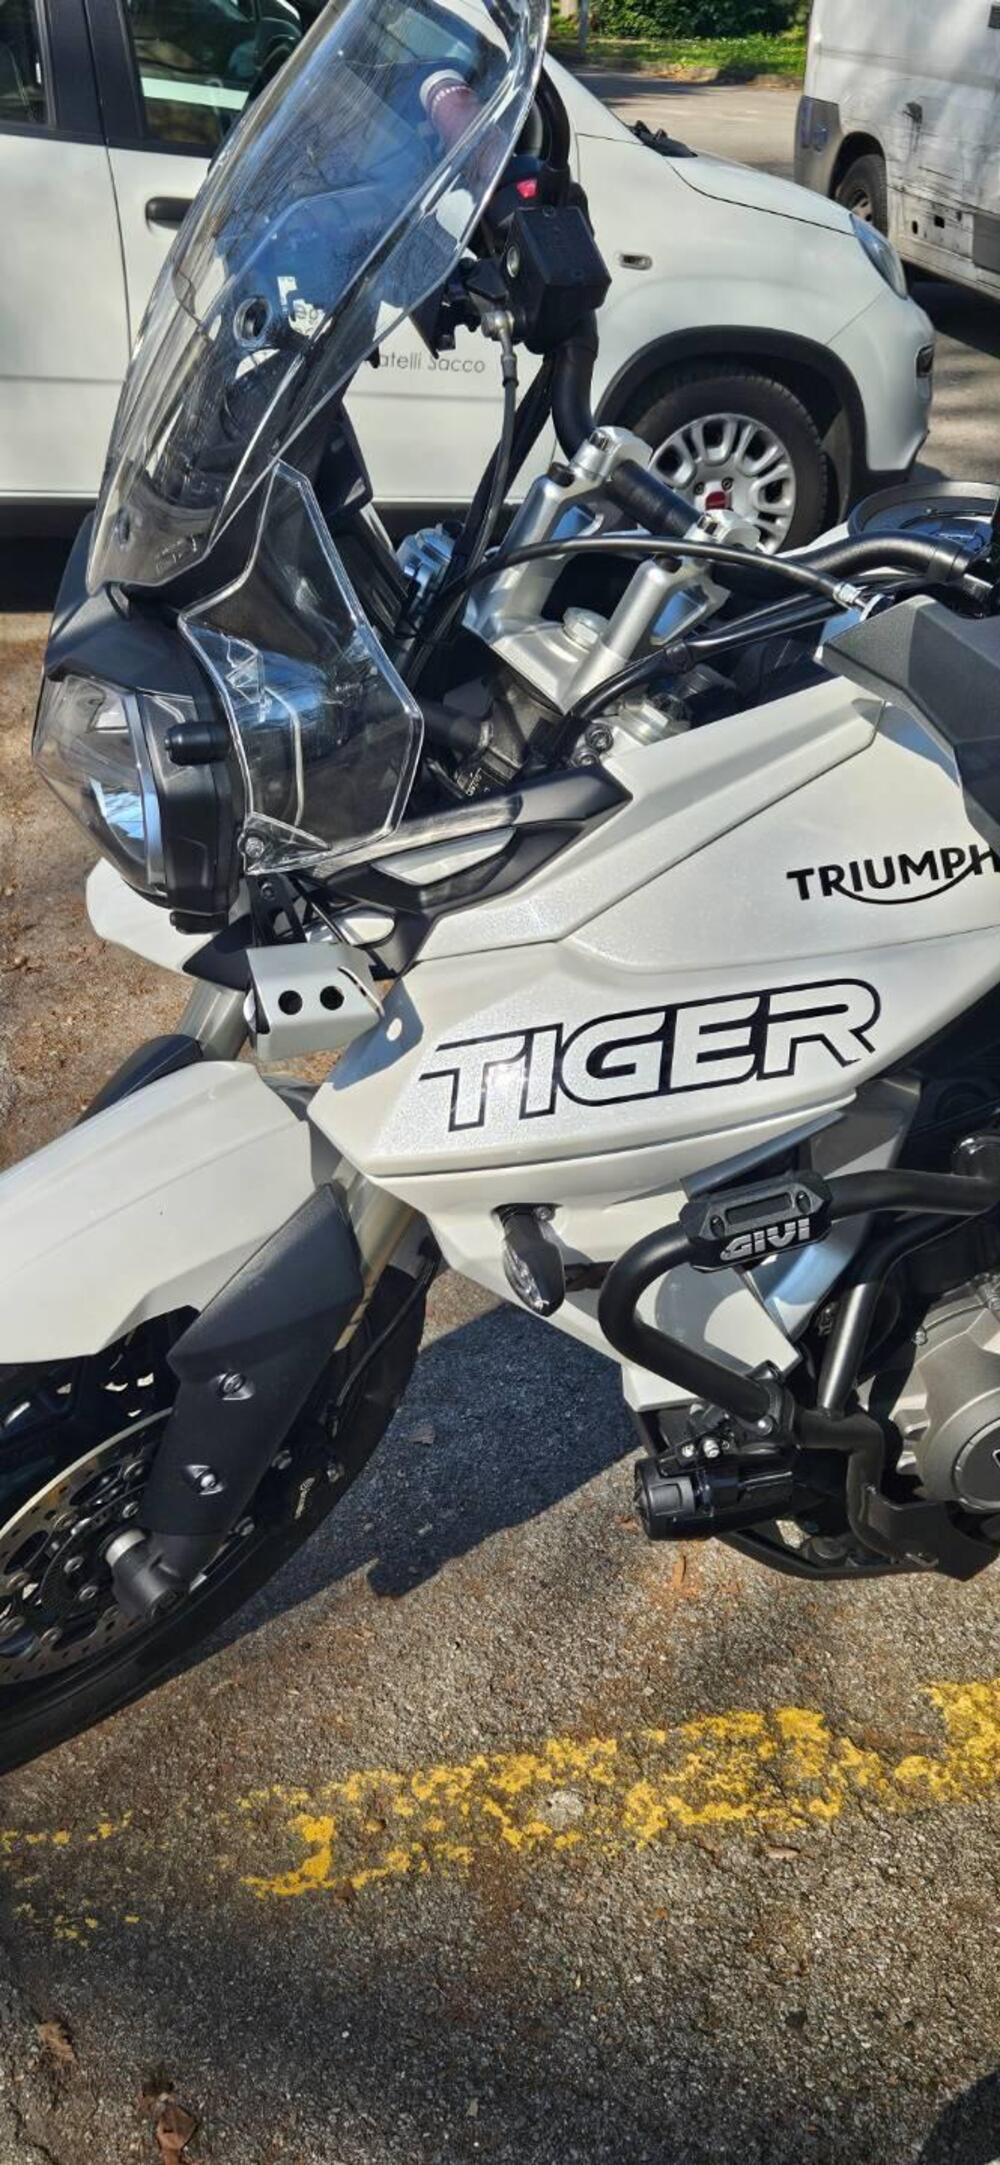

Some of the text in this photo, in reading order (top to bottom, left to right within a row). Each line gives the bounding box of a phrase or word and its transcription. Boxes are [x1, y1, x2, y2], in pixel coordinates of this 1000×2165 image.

[379, 351, 422, 370] atelli
[786, 844, 1000, 905] TRIUMPH
[419, 978, 881, 1132] TIGER
[719, 1217, 810, 1261] GIVI
